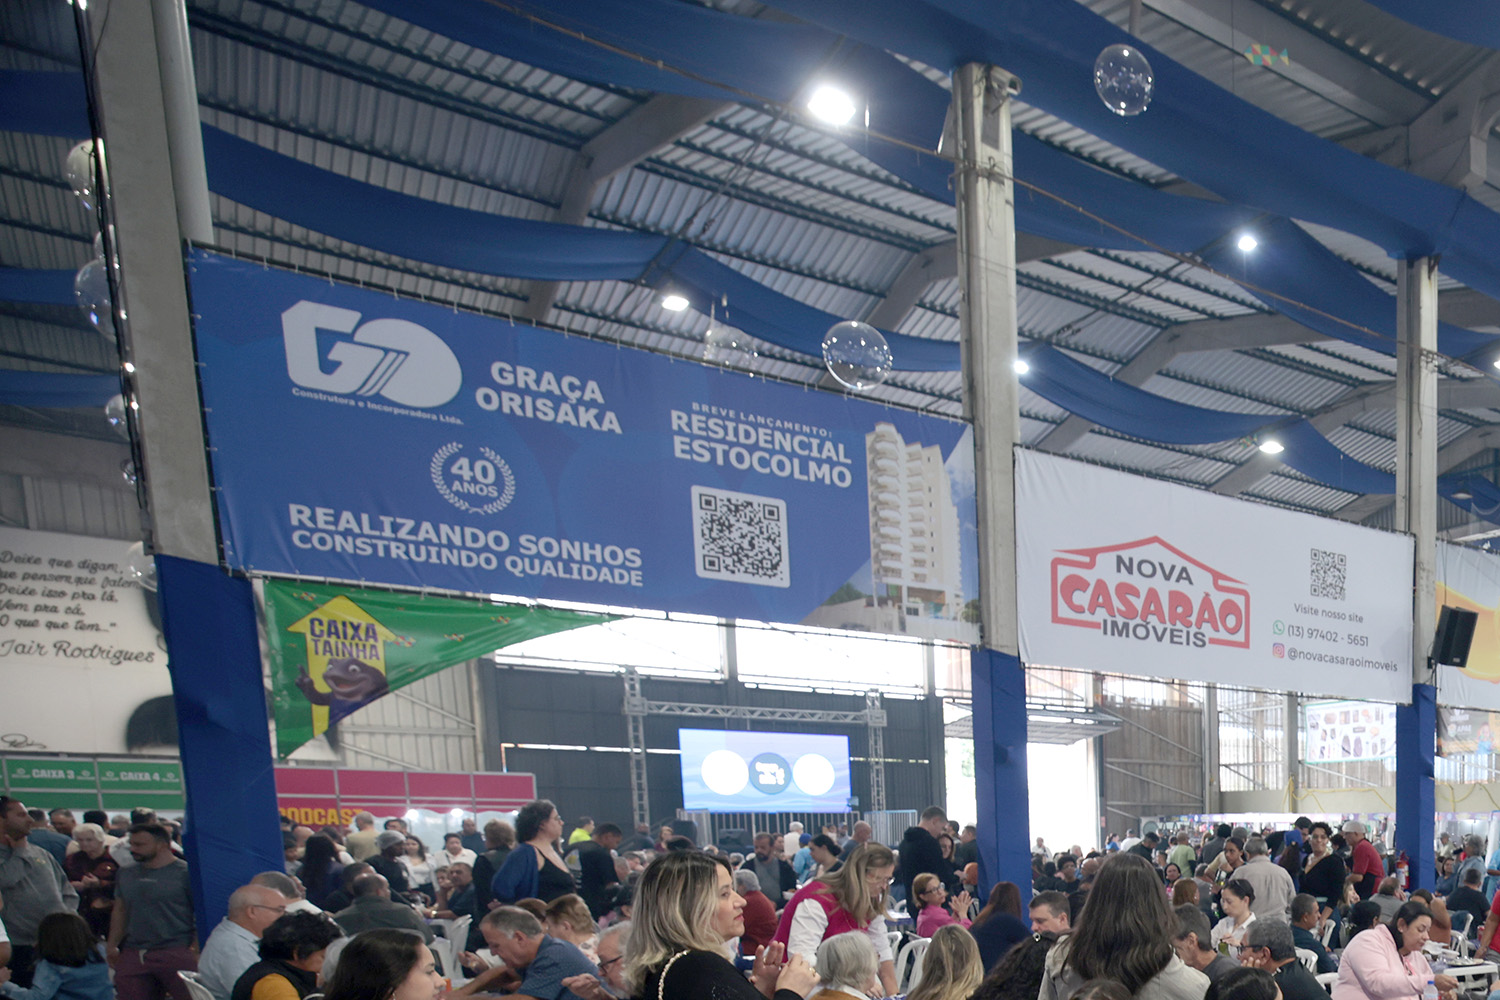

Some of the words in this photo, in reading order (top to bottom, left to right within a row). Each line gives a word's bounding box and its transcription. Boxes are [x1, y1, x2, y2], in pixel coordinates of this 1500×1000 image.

[490, 361, 605, 405] GRAÇA
[292, 387, 355, 406] Construtora
[367, 401, 437, 422] Incorporadora
[475, 387, 623, 435] ORISAKA
[692, 402, 736, 419] BREVE
[740, 412, 832, 438] LANÇAMENTO:
[671, 409, 852, 464] RESIDENCIAL
[451, 457, 495, 485] 40
[673, 435, 851, 488] ESTOCOLMO
[451, 480, 498, 498] ANOS
[289, 503, 510, 552] REALIZANDO
[518, 534, 642, 568] SONHOS
[48, 558, 74, 569] que
[292, 530, 498, 570] CONSTRUINDO
[505, 555, 643, 587] QUALIDADE
[1116, 554, 1194, 586] NOVA
[33, 604, 60, 614] pra
[71, 592, 97, 602] pra
[1060, 573, 1243, 635] CASARÃO
[14, 618, 40, 629] que
[45, 620, 70, 630] que
[1294, 602, 1319, 617] Visite
[1320, 607, 1346, 621] nosso
[1348, 612, 1364, 623] site
[310, 618, 378, 642] CAIXA
[1102, 618, 1207, 648] IMÓVEIS
[1287, 624, 1305, 639] (13)
[1307, 627, 1338, 643] 97402
[1347, 633, 1369, 647] 5651
[0, 639, 48, 658] Jair
[53, 640, 156, 665] Rodrigues
[311, 638, 380, 660] TAINHA
[1287, 648, 1398, 673] @novacasaraoimoveis
[32, 768, 64, 780] CAIXA
[66, 768, 75, 780] 3
[120, 771, 149, 782] CAIXA
[151, 771, 161, 782] 4
